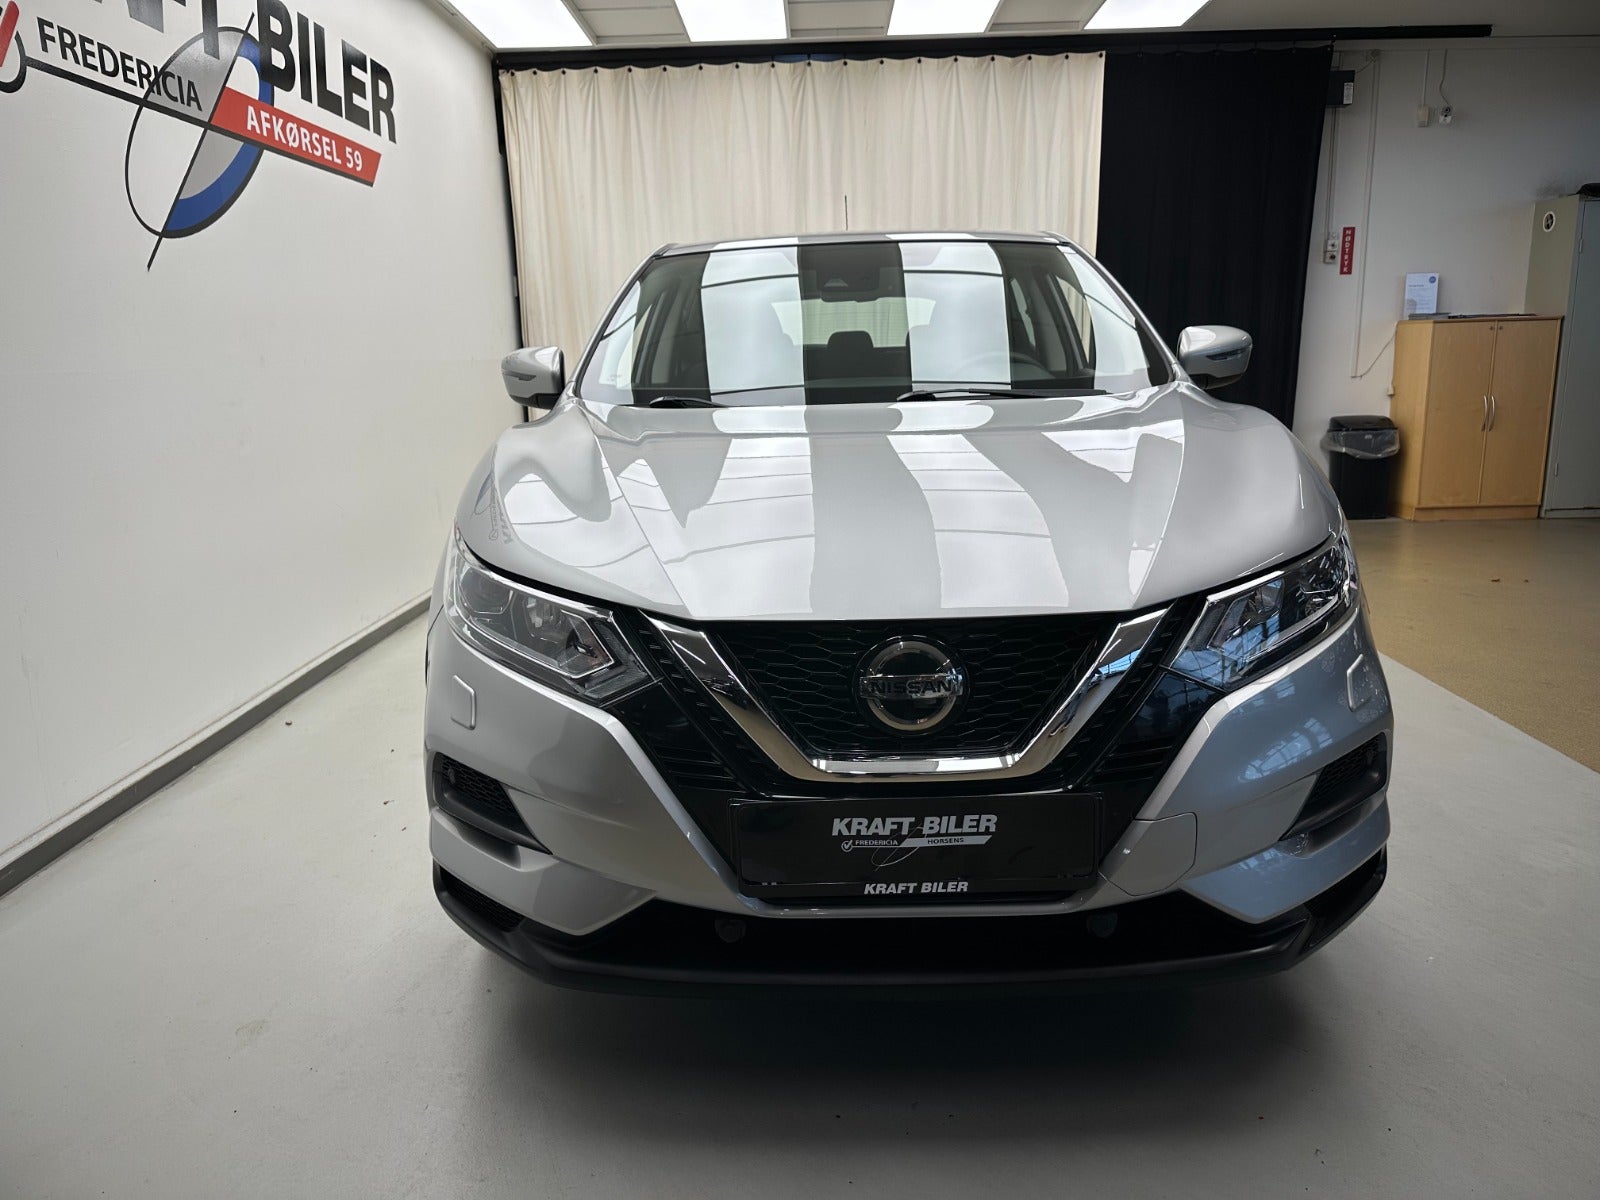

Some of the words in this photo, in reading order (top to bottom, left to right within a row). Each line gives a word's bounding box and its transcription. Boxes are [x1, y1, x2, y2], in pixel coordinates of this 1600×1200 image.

[37, 16, 203, 112] FREDERICIA
[256, 0, 397, 144] BILER
[247, 105, 342, 165] AFKØRSEL
[345, 146, 363, 172] 59
[867, 679, 953, 695] NISSAN
[832, 817, 915, 836] KRAFT
[922, 814, 998, 834] BILER
[927, 837, 965, 845] HORSENS
[864, 883, 917, 895] KRAFT
[920, 881, 969, 893] BILER
